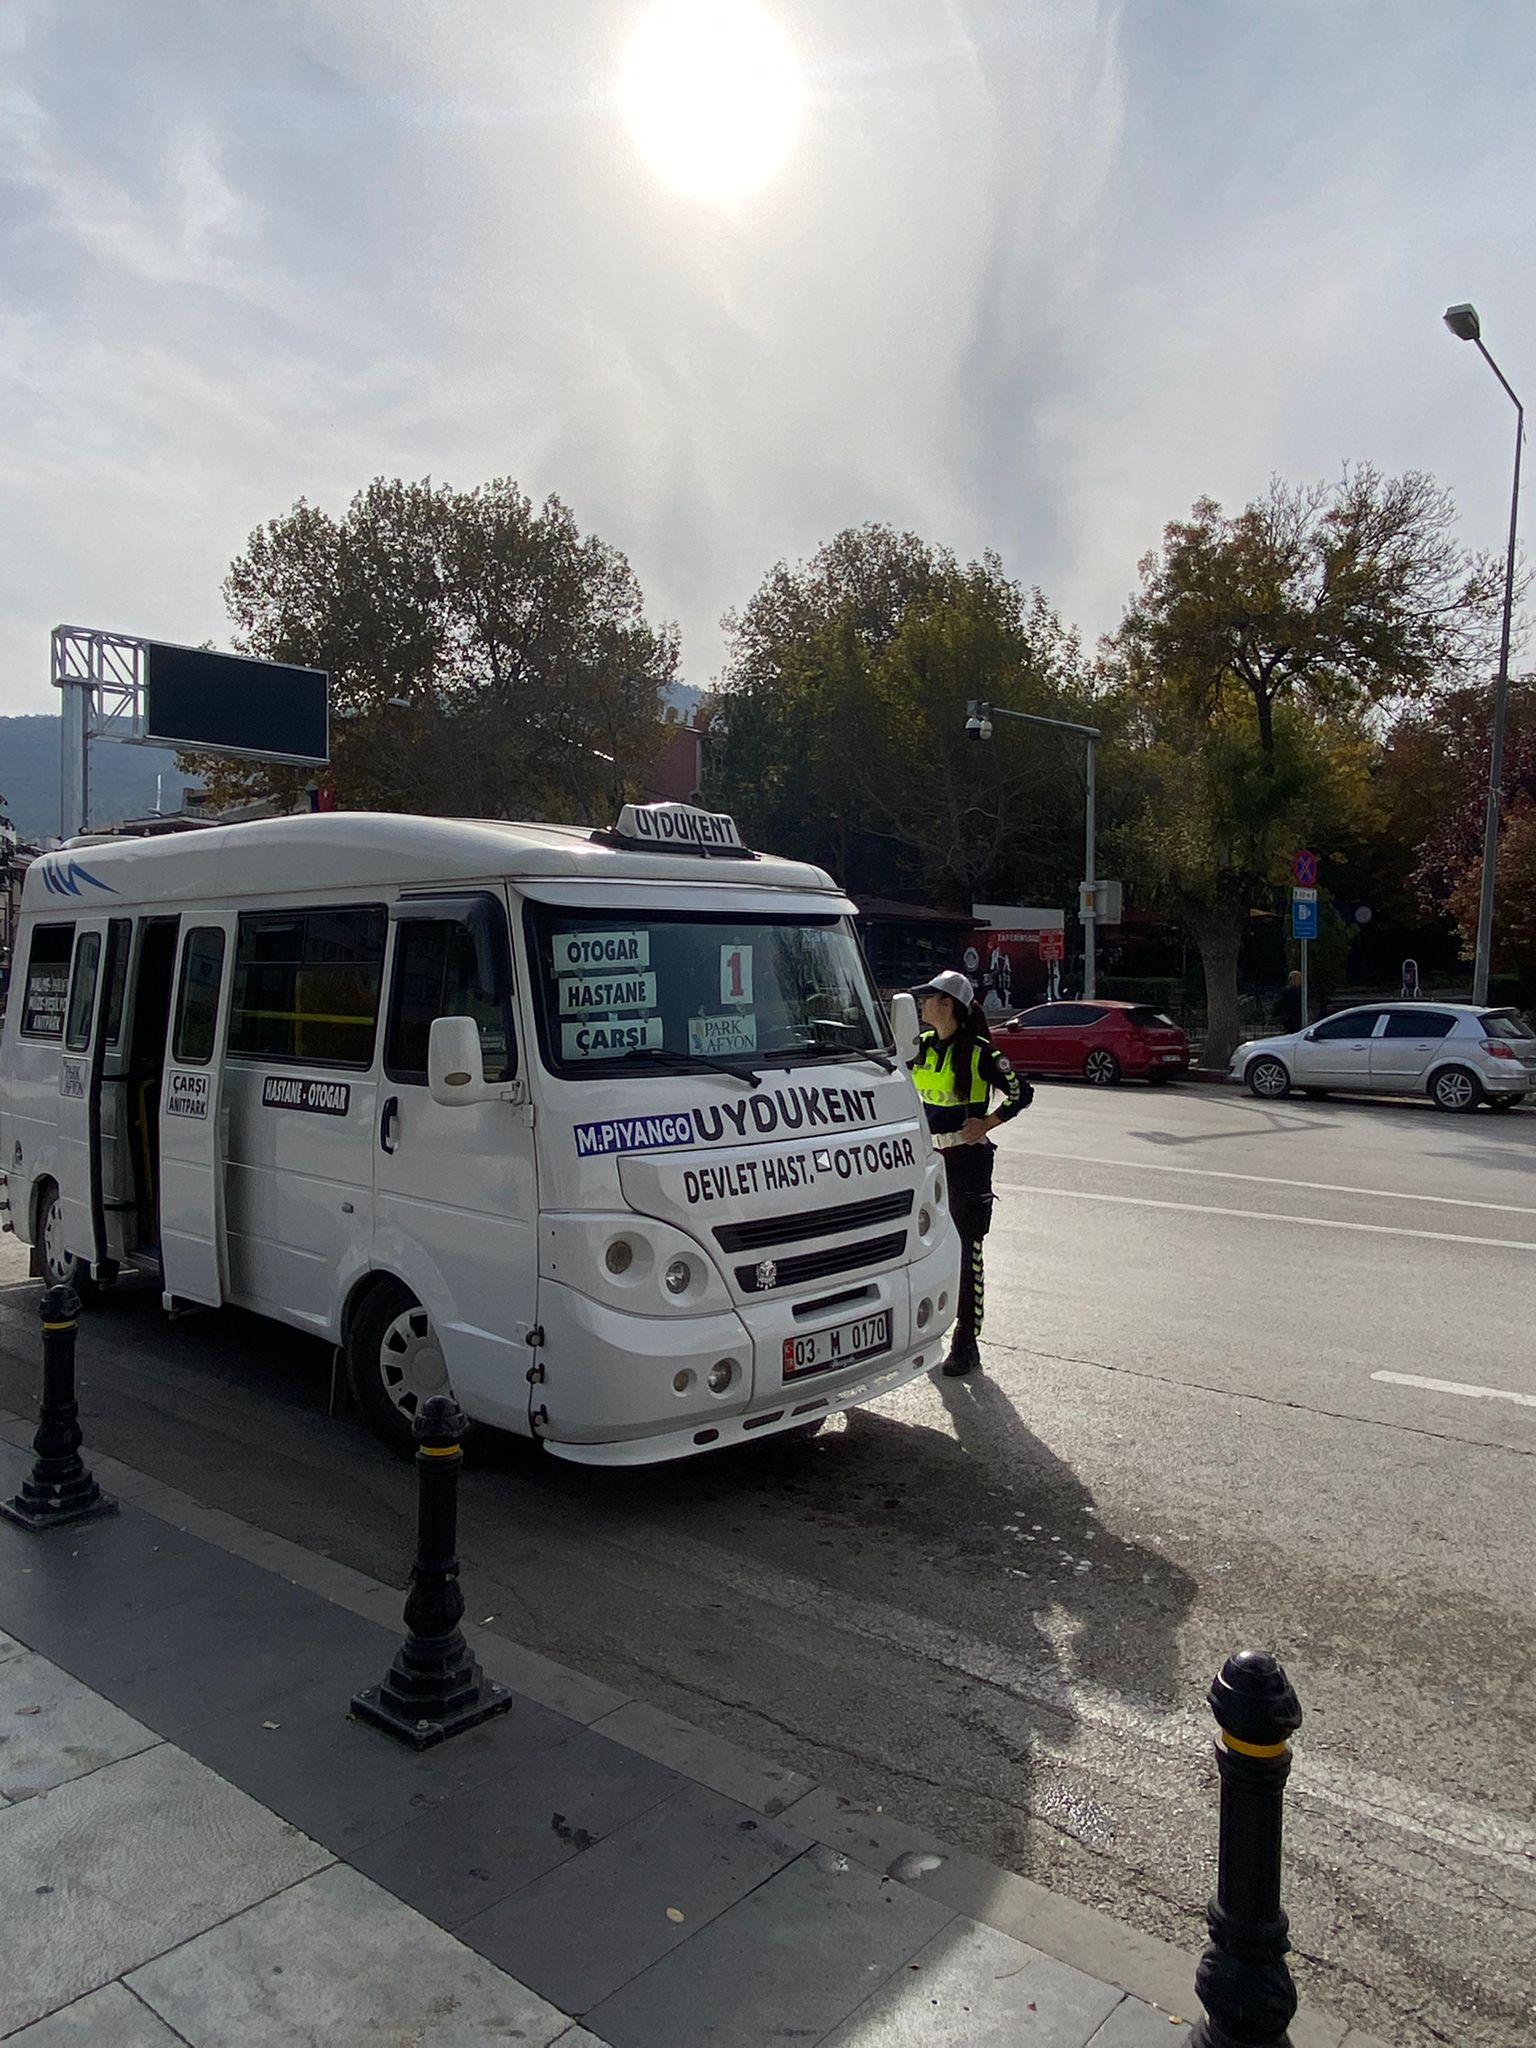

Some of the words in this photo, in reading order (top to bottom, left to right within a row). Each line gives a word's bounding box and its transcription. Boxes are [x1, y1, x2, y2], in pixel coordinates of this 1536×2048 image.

[635, 809, 734, 844] UYDUKENT
[567, 938, 639, 963] OTOGAR
[726, 952, 744, 997] 1
[567, 981, 646, 1007] HASTANE
[704, 1020, 742, 1037] PARK
[705, 1034, 754, 1053] AFYON
[173, 1075, 206, 1097] ÇARŞI
[265, 1079, 303, 1105] HASTANE
[308, 1083, 347, 1110] OTOGAR
[170, 1097, 207, 1117] ANITPARK
[692, 1087, 879, 1141] UYDUKENT
[683, 1163, 758, 1204] DEVLET
[765, 1153, 815, 1193] HAST.
[834, 1137, 916, 1179] OTOGAR
[795, 1338, 815, 1366] 03
[830, 1330, 841, 1358] M
[852, 1317, 885, 1350] 0170
